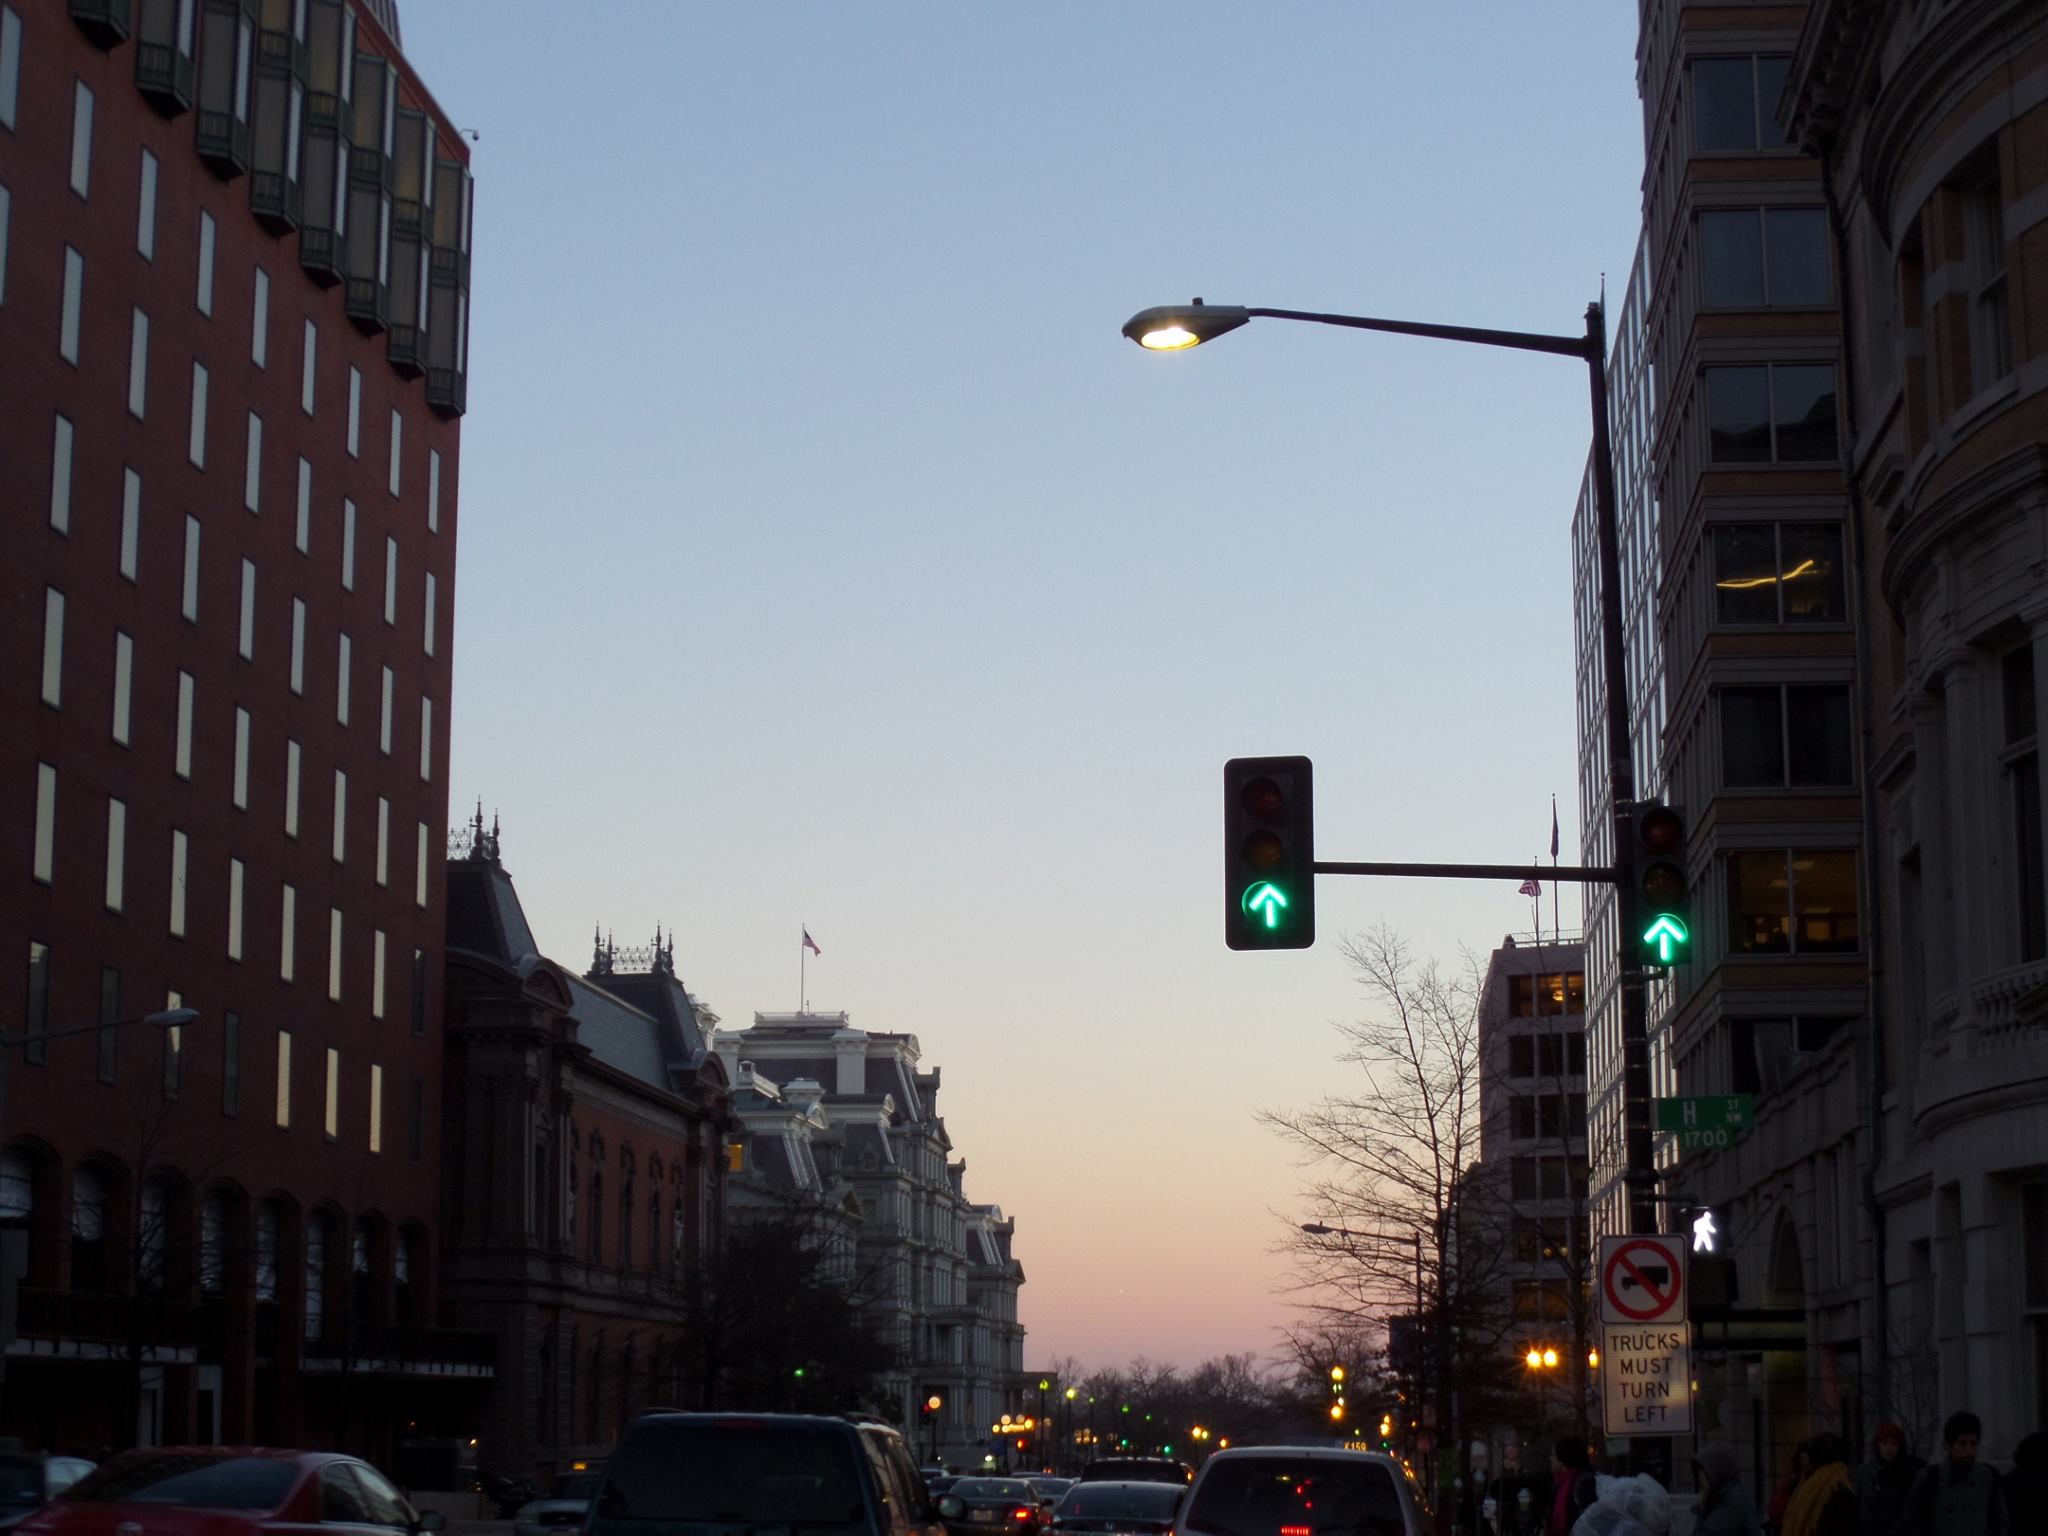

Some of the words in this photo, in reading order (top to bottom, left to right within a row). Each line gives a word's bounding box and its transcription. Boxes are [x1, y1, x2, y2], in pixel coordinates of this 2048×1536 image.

[1682, 1100, 1697, 1126] H
[1727, 1099, 1739, 1111] ST
[1726, 1112, 1742, 1124] NW
[1684, 1129, 1728, 1149] 1700
[1610, 1333, 1680, 1352] TRUCKS
[1620, 1357, 1672, 1375] MUST
[1620, 1381, 1669, 1399] TURN
[1624, 1405, 1668, 1423] LEFT
